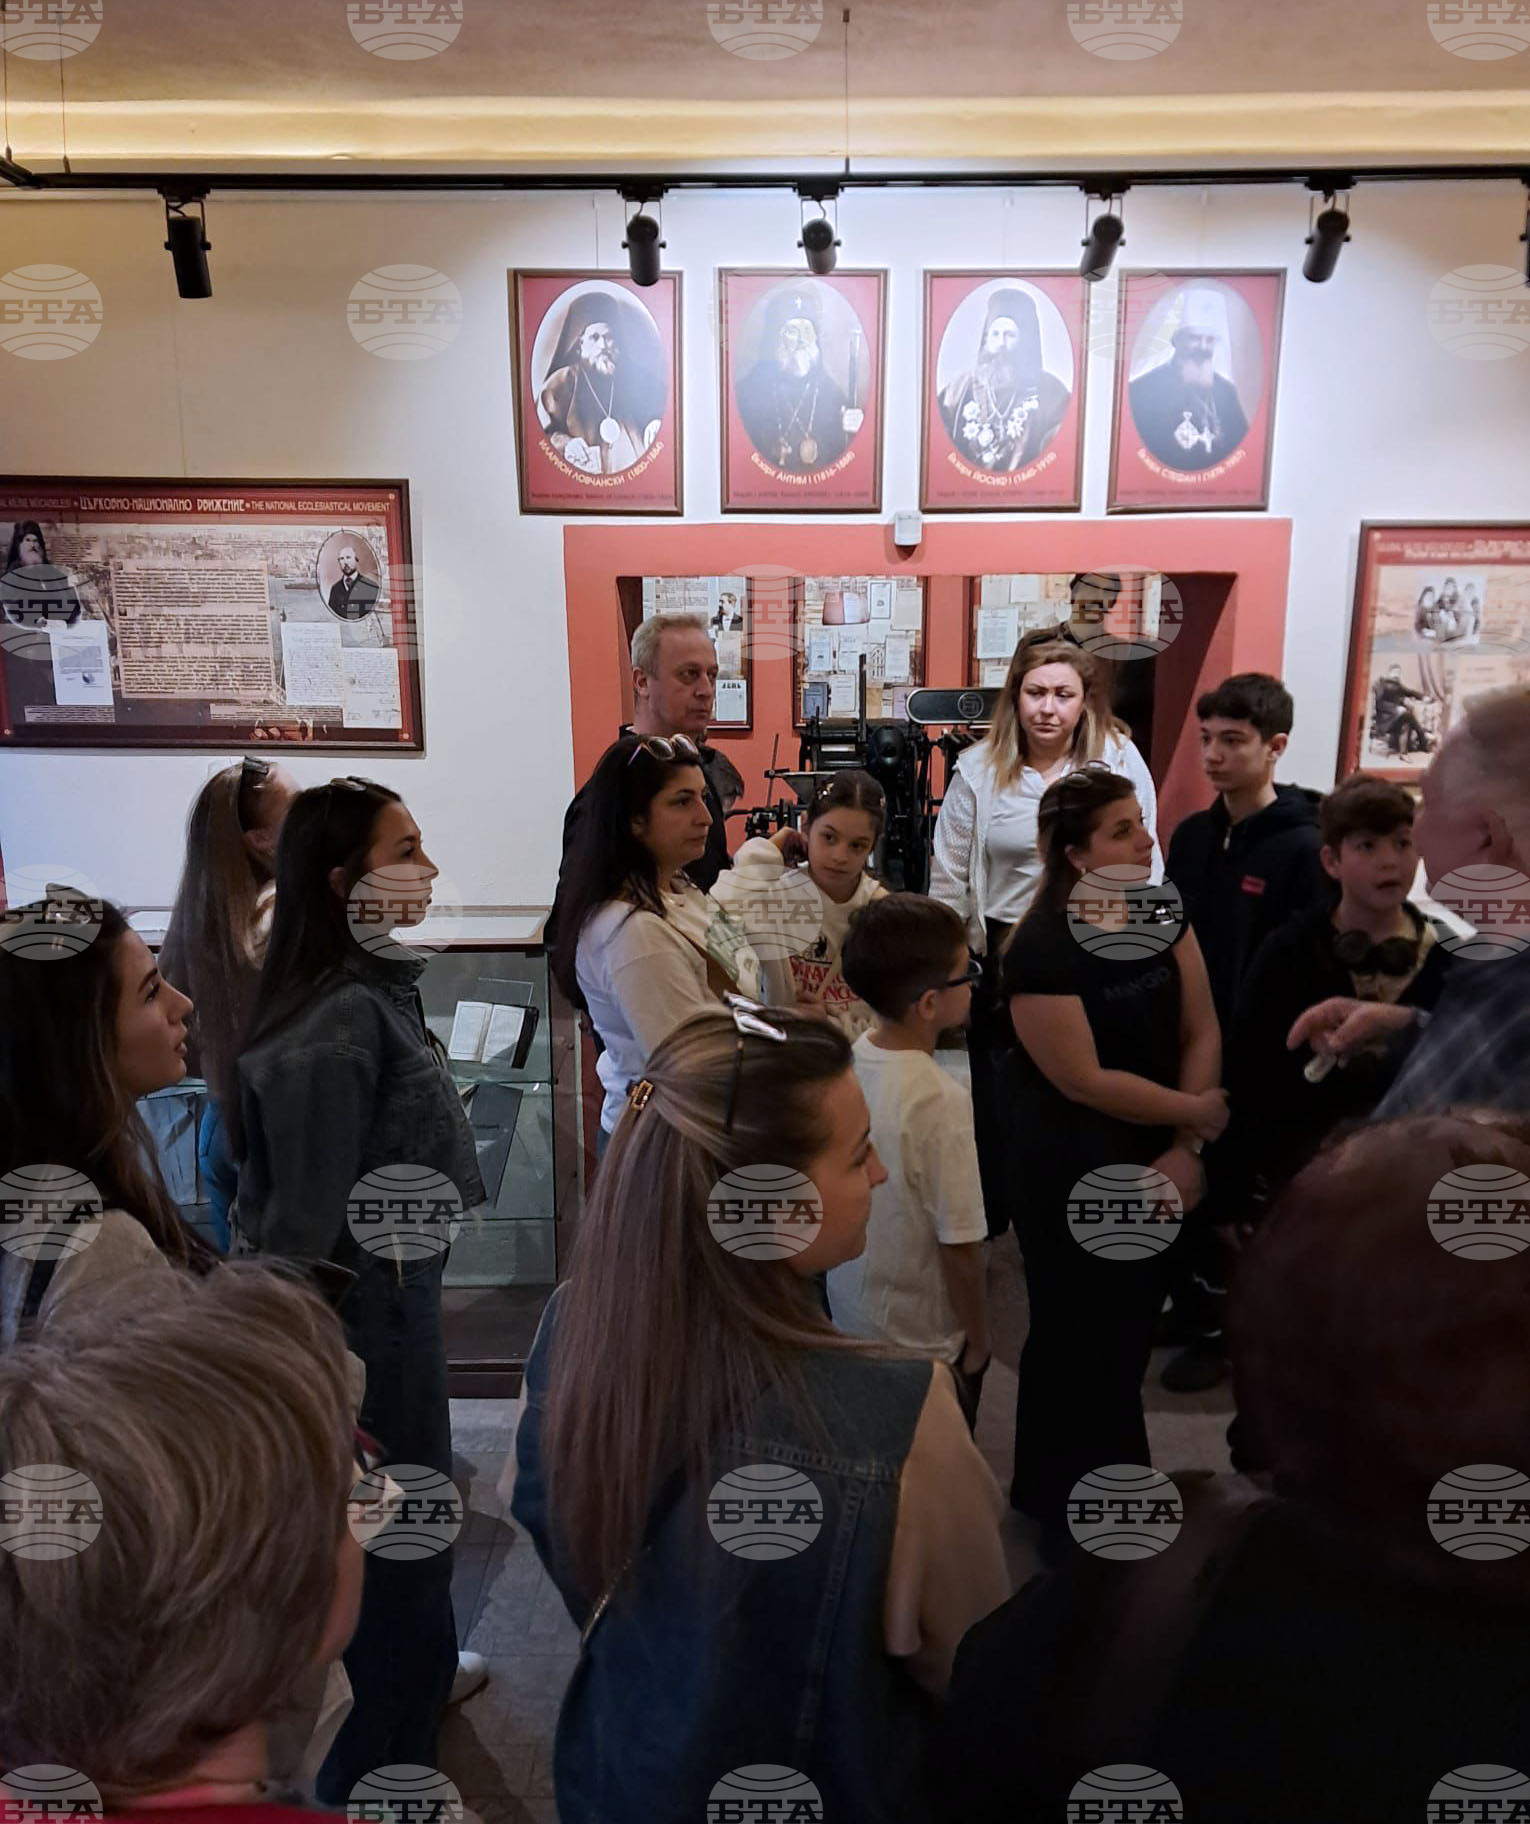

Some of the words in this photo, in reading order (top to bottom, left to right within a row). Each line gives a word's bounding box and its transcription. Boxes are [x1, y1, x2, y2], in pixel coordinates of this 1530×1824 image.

[571, 471, 625, 488] ЛОВЧАНСКИ
[776, 471, 808, 486] АНТИМ
[197, 498, 245, 512] ДВИЖЕНИЕ
[250, 500, 265, 511] THE
[265, 500, 297, 511] NATIONAL
[297, 501, 352, 511] ECCLESIASTICAL
[352, 501, 391, 512] MOVEMENT
